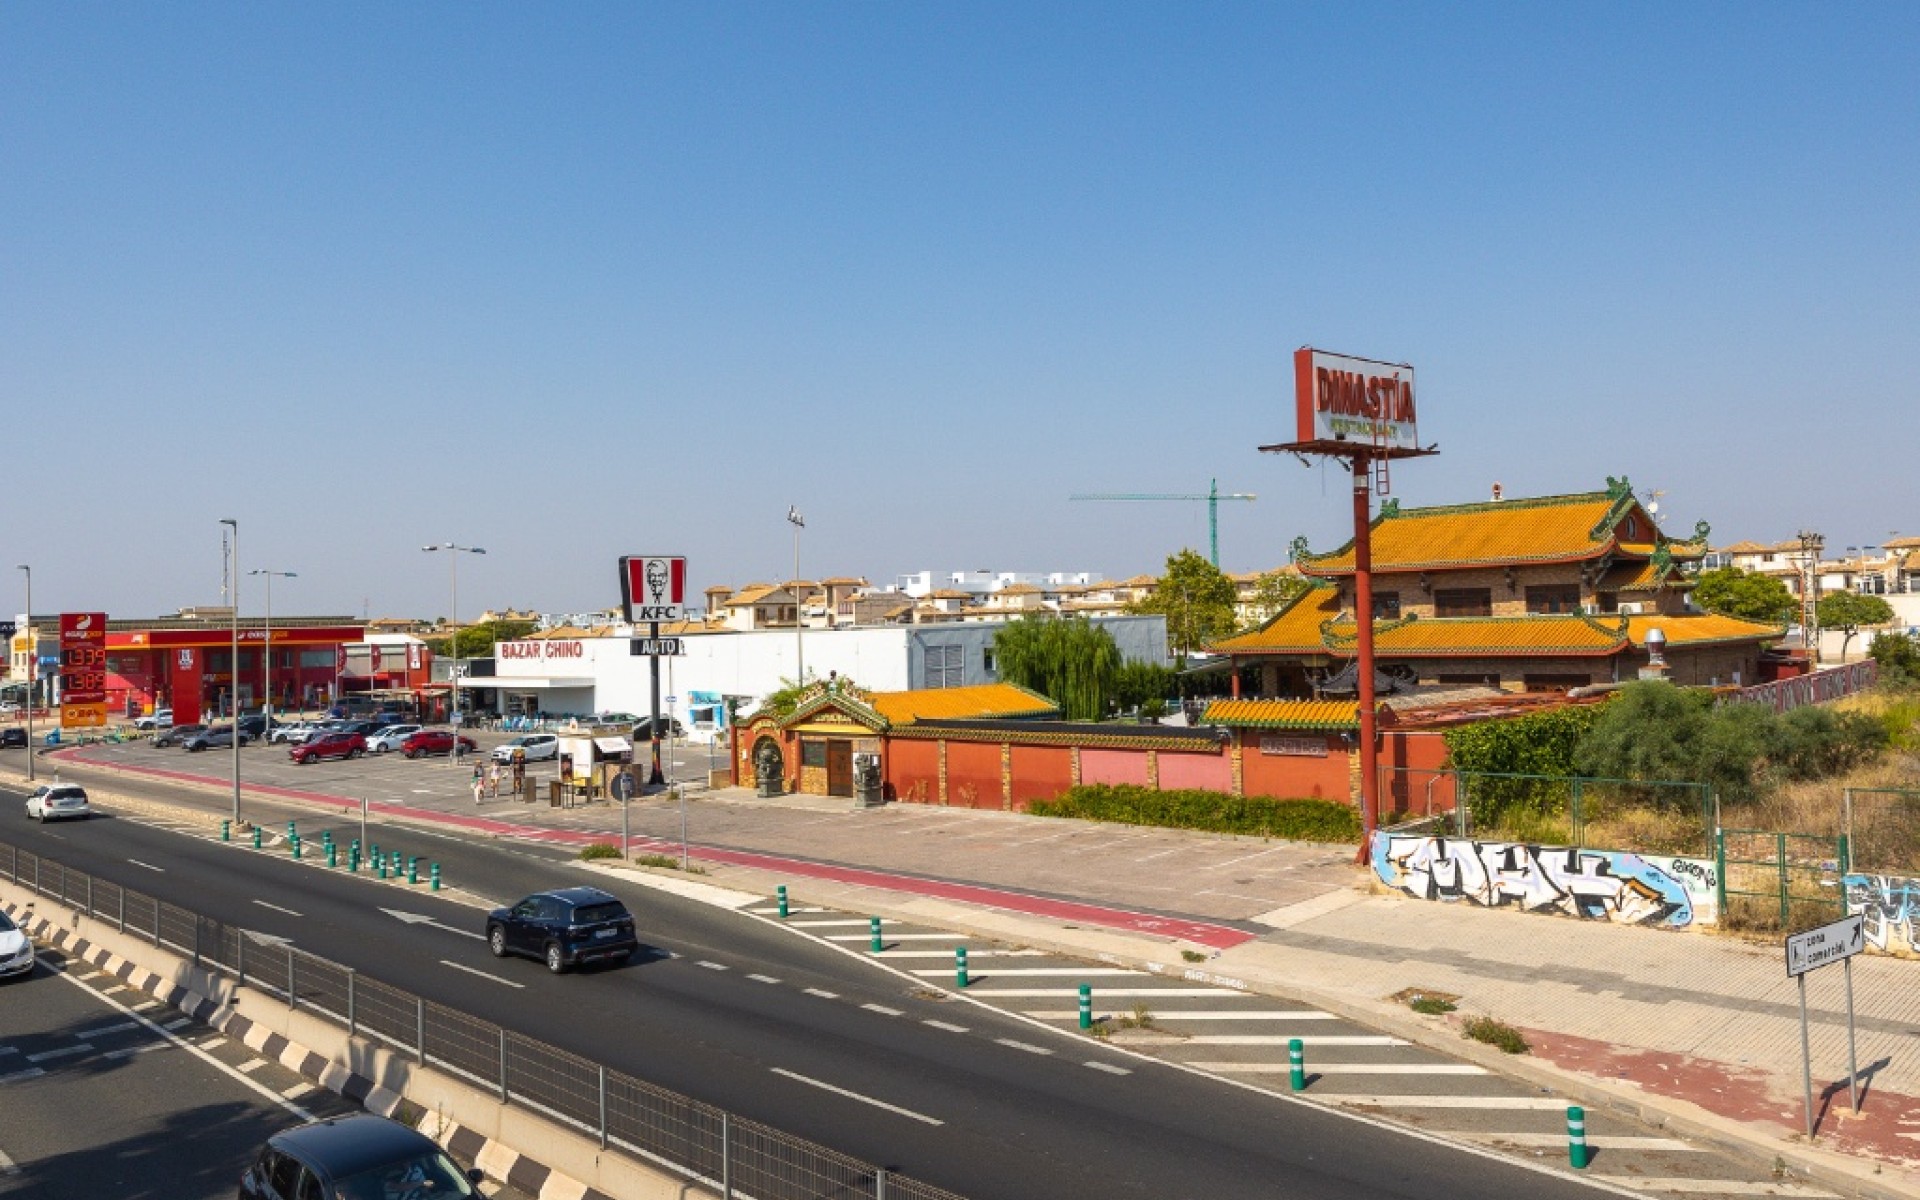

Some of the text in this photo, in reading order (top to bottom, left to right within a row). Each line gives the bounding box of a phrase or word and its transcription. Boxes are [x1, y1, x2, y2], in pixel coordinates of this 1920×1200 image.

[1317, 367, 1416, 423] DINASTÍA
[641, 606, 676, 619] KFC
[502, 641, 584, 659] BAZAR CHINO
[1807, 933, 1825, 947] zona
[1807, 940, 1845, 964] comercial
